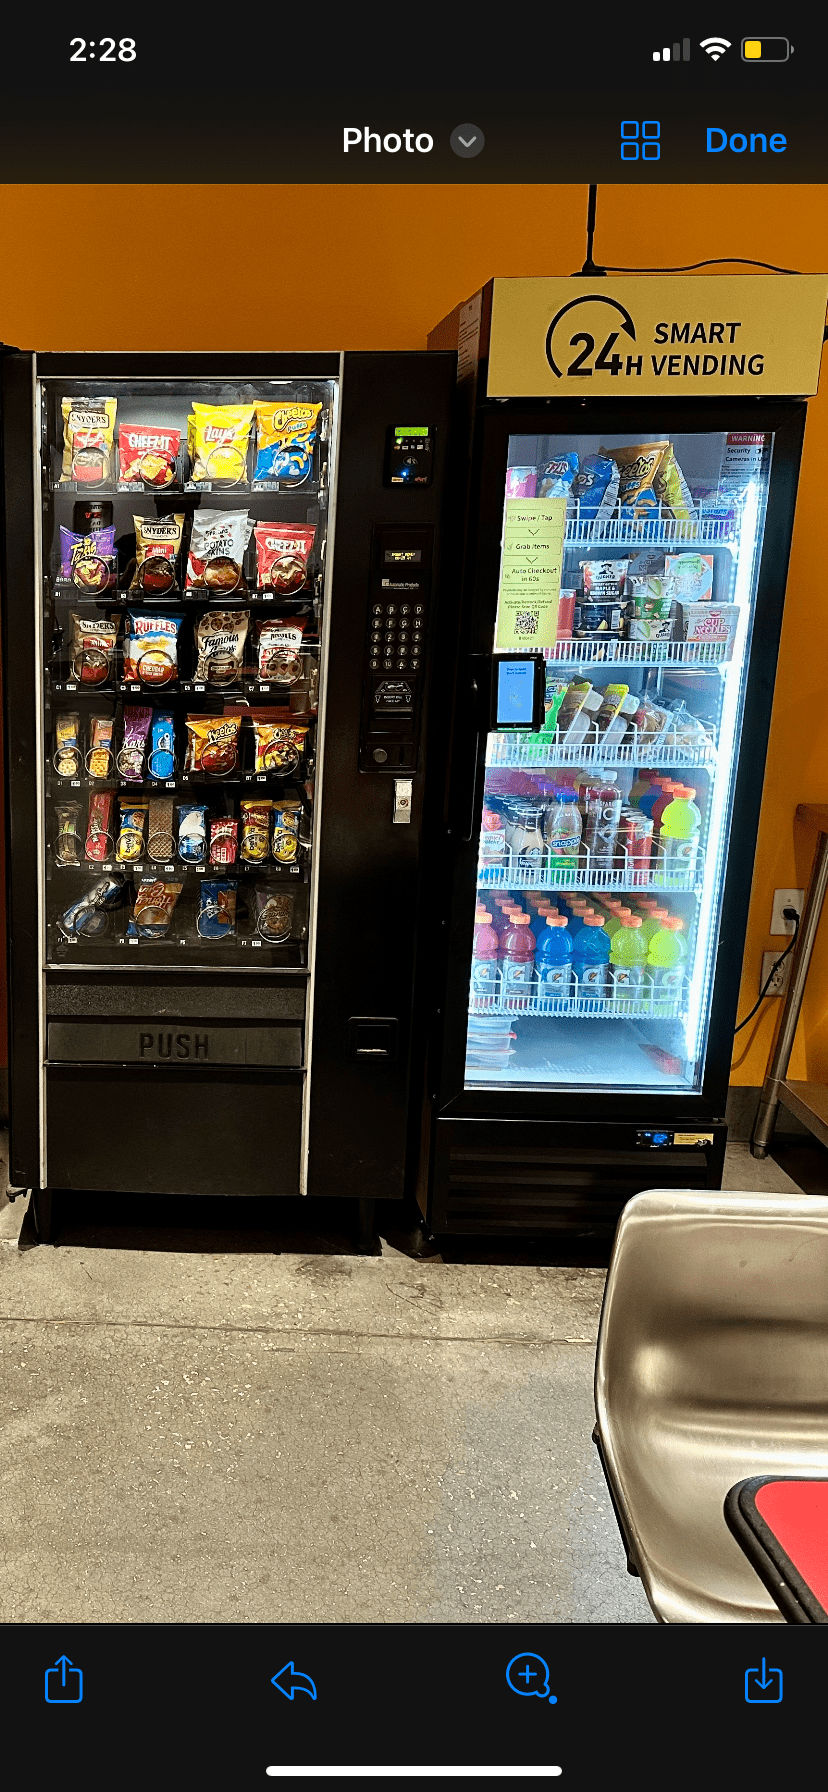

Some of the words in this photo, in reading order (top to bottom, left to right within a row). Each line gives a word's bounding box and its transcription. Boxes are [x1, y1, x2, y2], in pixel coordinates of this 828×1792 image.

[653, 322, 741, 344] SMART
[651, 354, 765, 376] VENDING
[731, 434, 765, 442] WARNING
[517, 515, 536, 523] Swipe
[204, 539, 234, 549] POTATO
[134, 620, 176, 635] RUFFLES
[704, 618, 726, 626] CUP
[201, 634, 239, 651] Famous
[139, 1033, 209, 1060] PUSH
